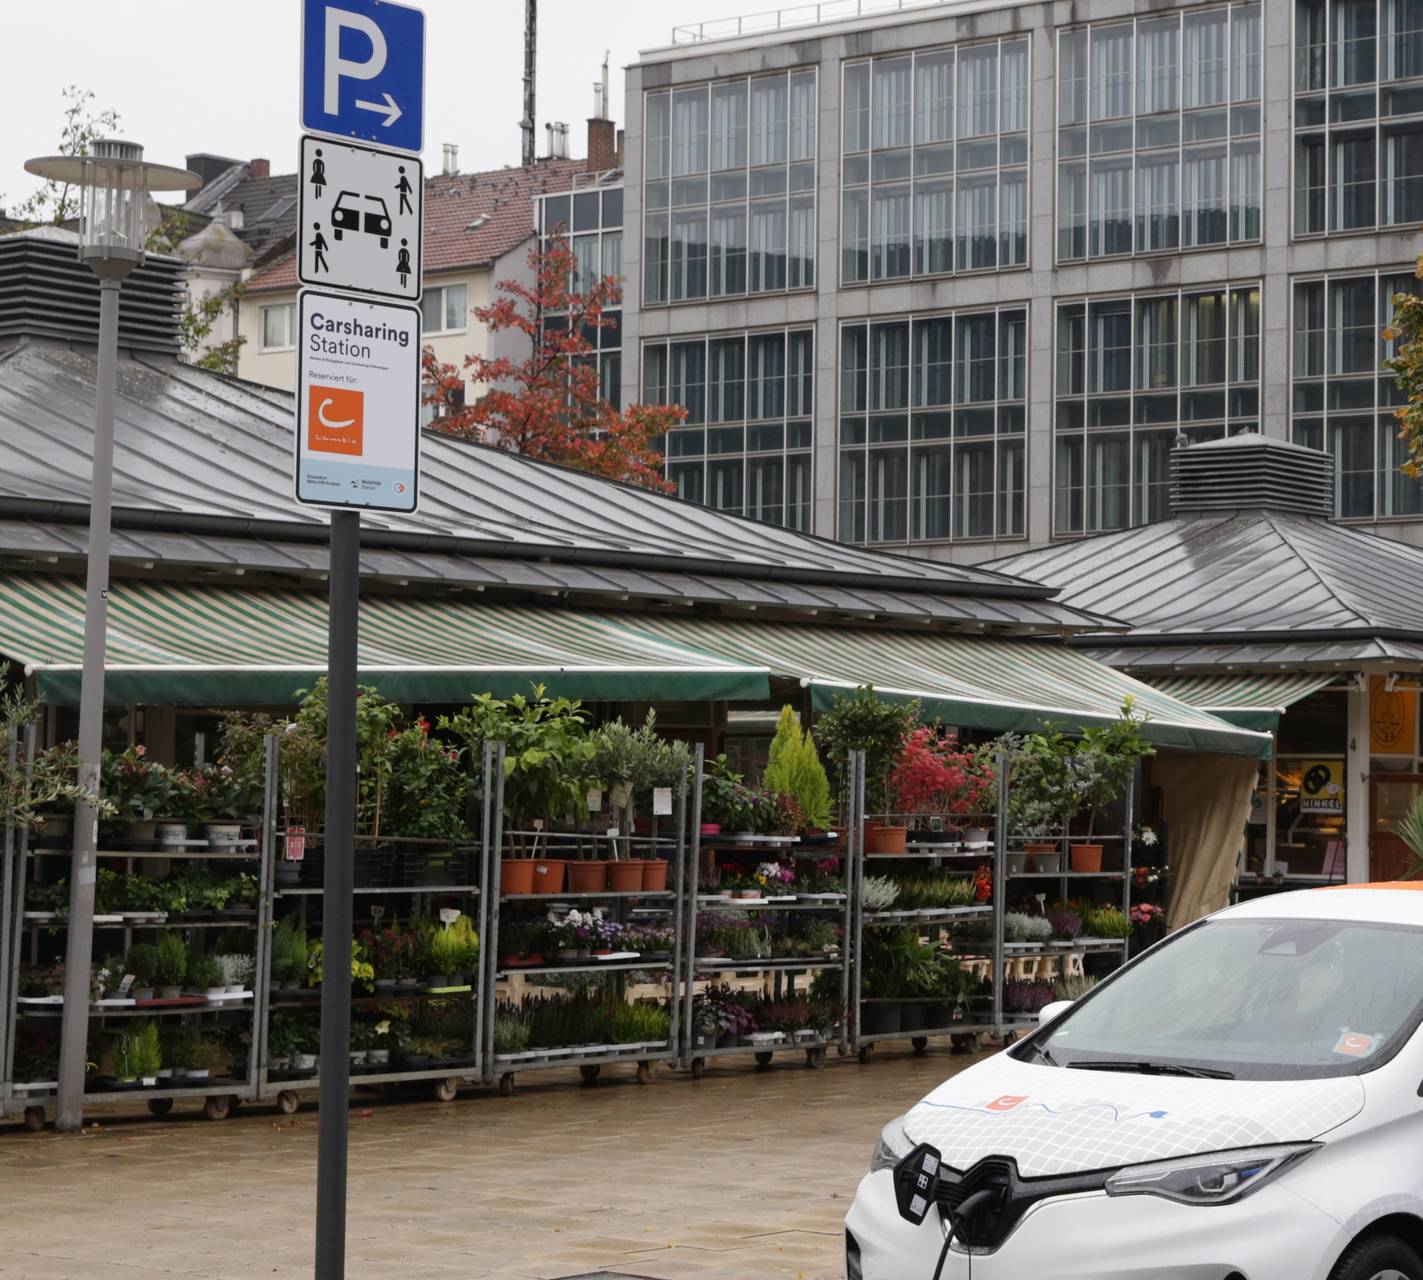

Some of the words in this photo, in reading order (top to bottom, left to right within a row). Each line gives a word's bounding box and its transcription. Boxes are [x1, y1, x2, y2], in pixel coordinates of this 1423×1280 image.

[324, 6, 388, 116] P
[310, 312, 409, 347] Carsharing
[310, 333, 371, 359] Station
[309, 370, 345, 382] Reserviert
